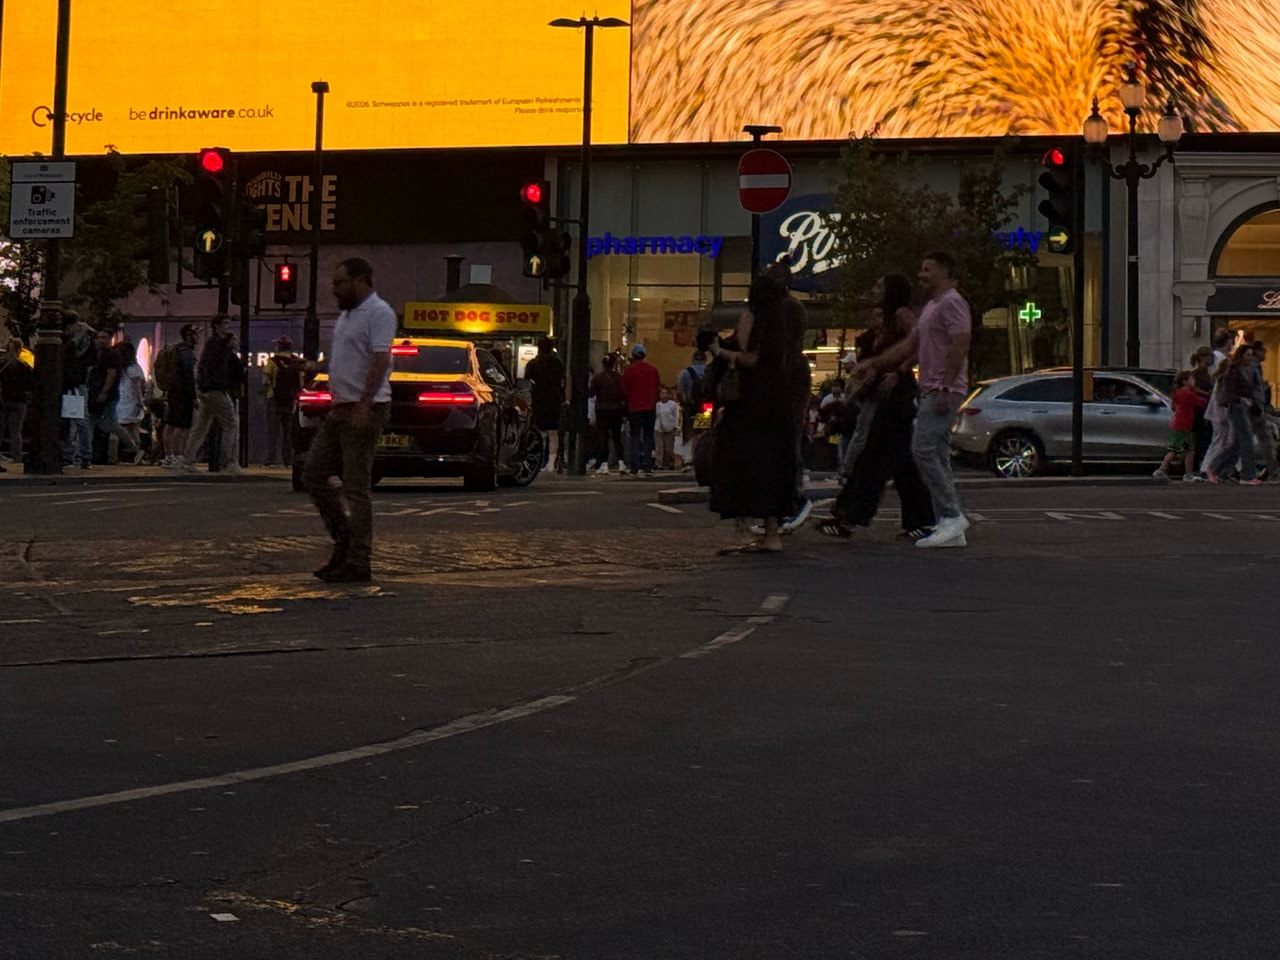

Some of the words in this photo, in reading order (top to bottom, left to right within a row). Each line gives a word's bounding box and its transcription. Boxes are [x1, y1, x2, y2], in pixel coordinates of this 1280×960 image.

[64, 106, 104, 126] ecycle
[27, 208, 57, 217] Traffic
[257, 202, 337, 232] ENUE
[13, 217, 71, 227] enforcement
[22, 227, 61, 235] cameras
[586, 231, 725, 261] pharmacy
[413, 309, 450, 322] HOT
[454, 310, 491, 323] DOG
[495, 311, 540, 324] SPOT
